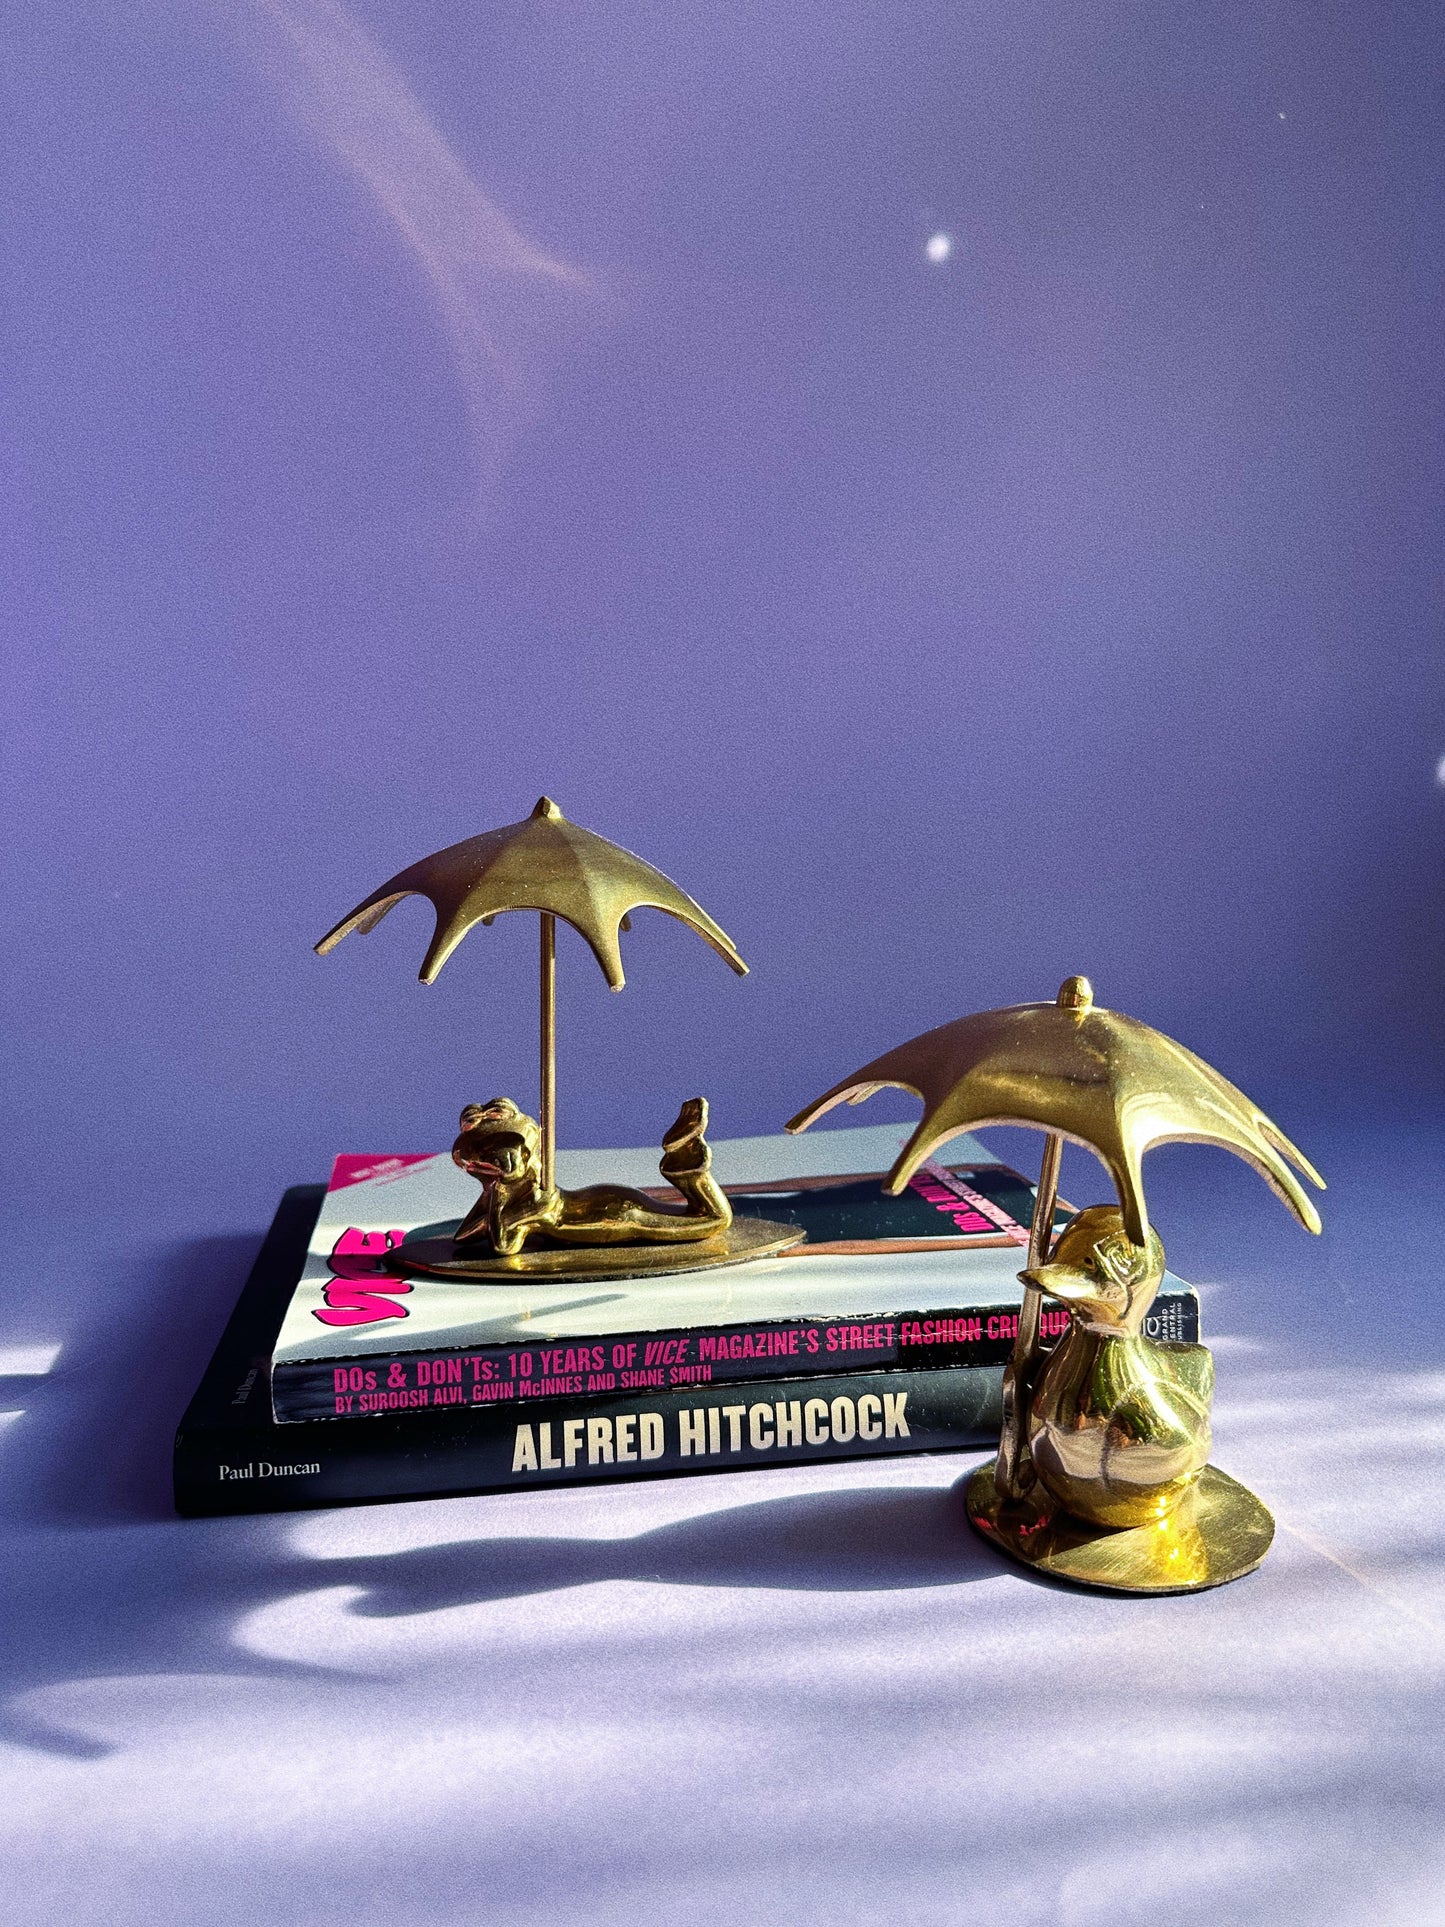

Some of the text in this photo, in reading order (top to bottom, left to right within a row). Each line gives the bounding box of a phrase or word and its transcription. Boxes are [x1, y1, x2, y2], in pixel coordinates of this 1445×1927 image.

[1161, 1308, 1169, 1341] GRAND
[1169, 1302, 1177, 1341] ENTRAL
[334, 1366, 377, 1393] DOs
[387, 1362, 407, 1388] &
[417, 1356, 500, 1386] DON'Ts:
[508, 1352, 533, 1378] 10
[540, 1346, 606, 1375] YEARS
[612, 1343, 637, 1369] OF
[644, 1339, 690, 1366] VICE
[700, 1329, 819, 1361] MAGAZINE'S
[826, 1323, 896, 1352] STREET
[901, 1317, 982, 1346] FASHION
[335, 1365, 712, 1414] BY SUROOSH ALVI, GAVIN McINNES AND SHANE SMITH
[511, 1392, 911, 1473] ALFRED HITCHCOCK
[219, 1462, 321, 1480] Paul Duncan
